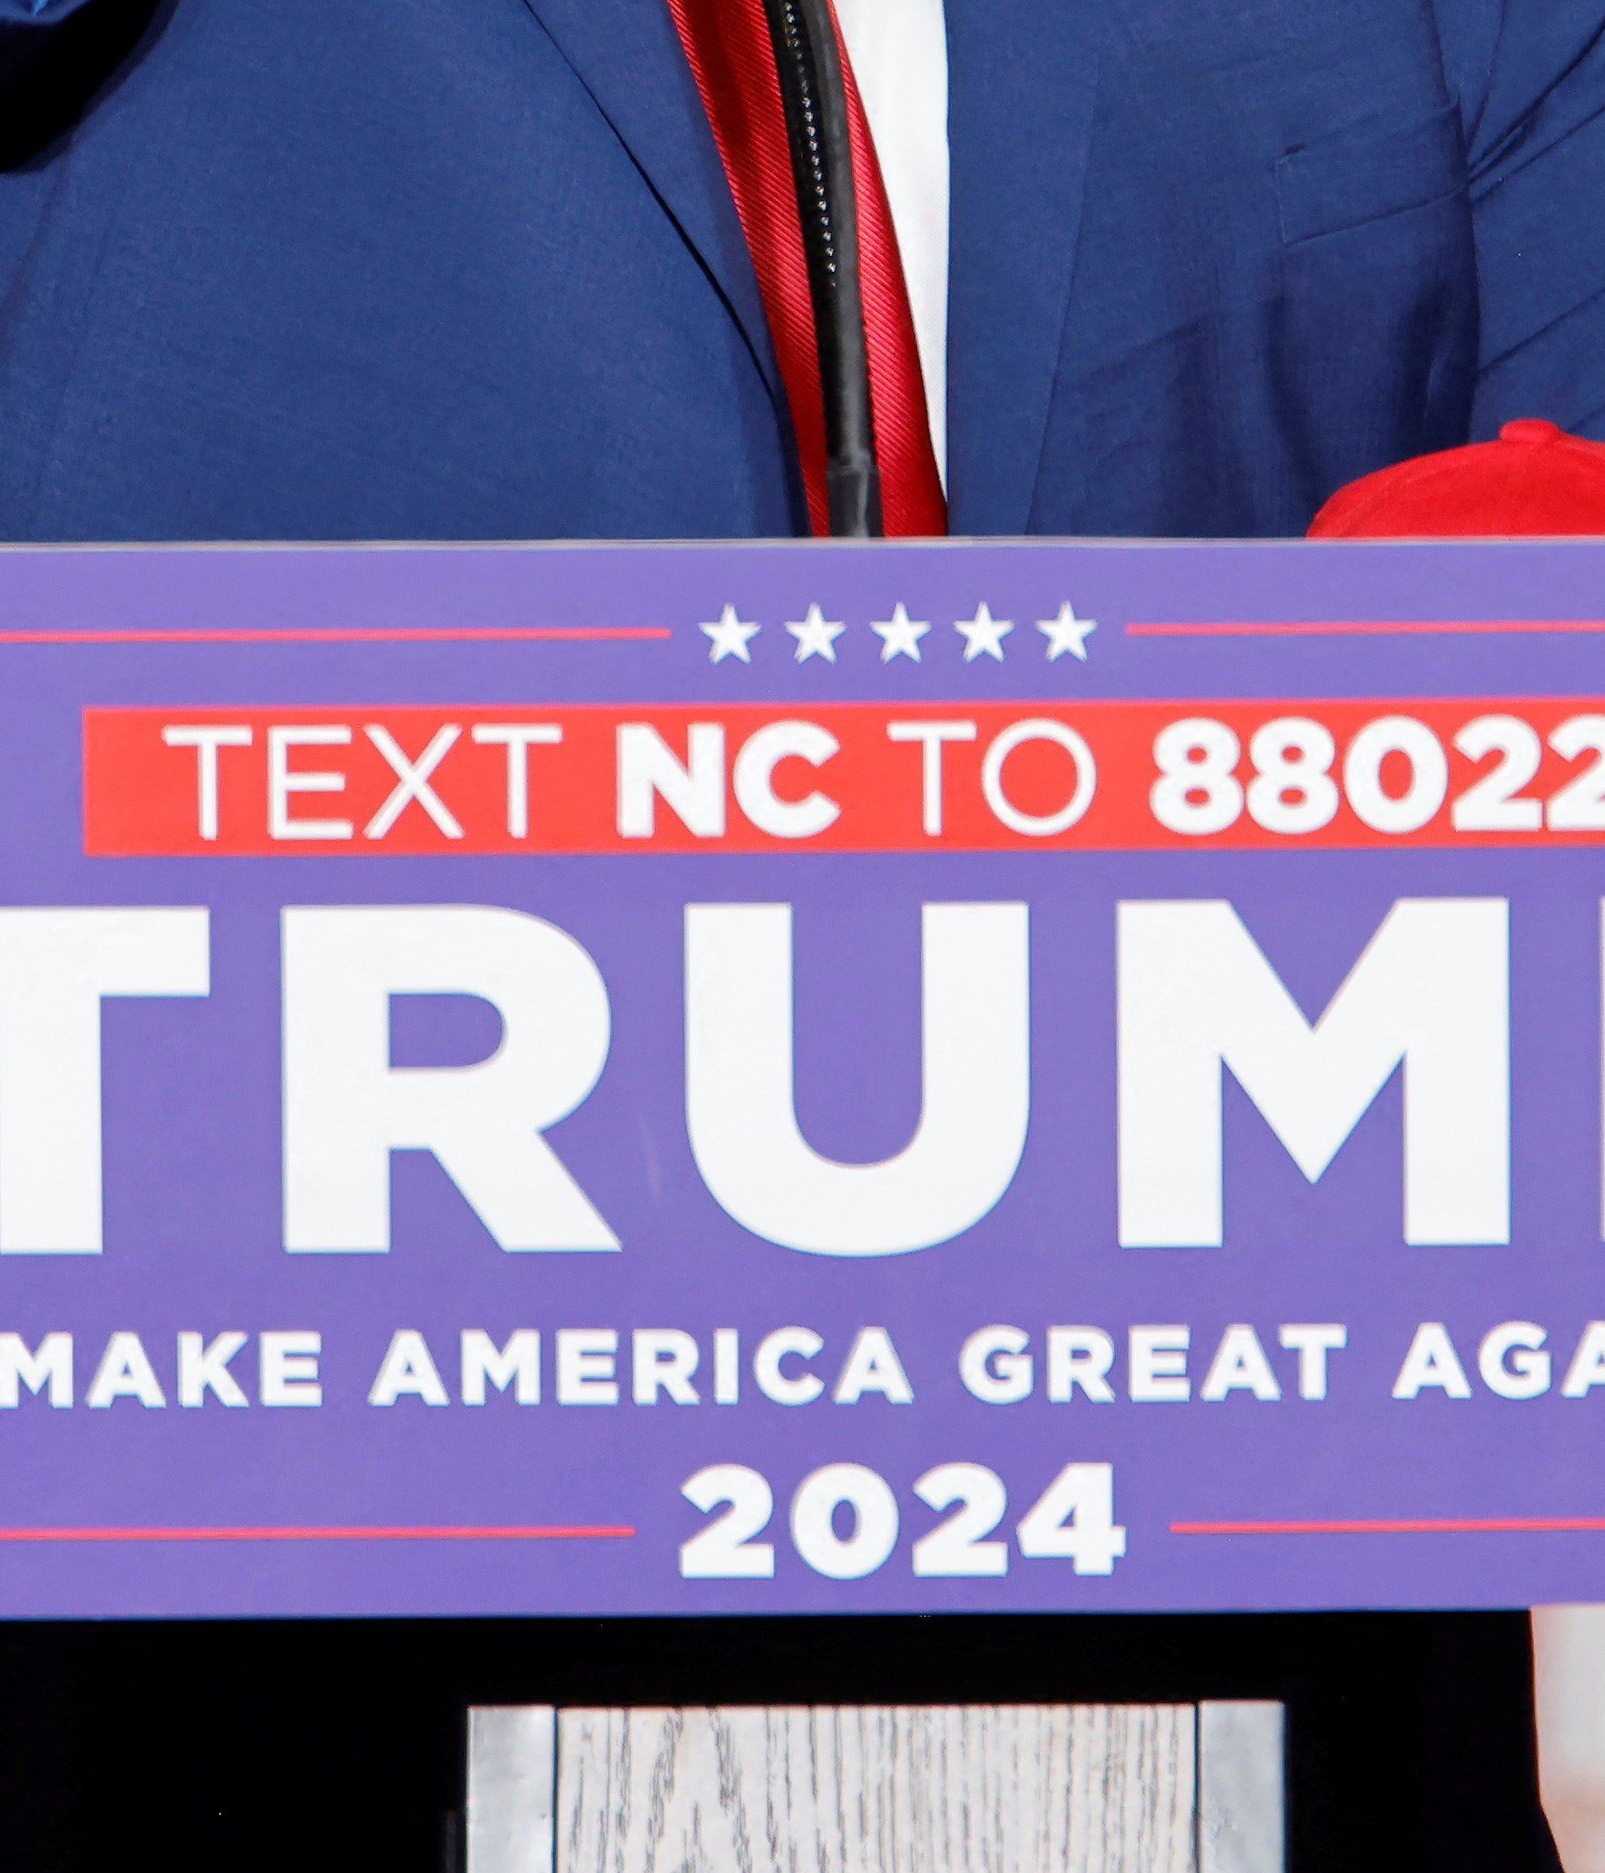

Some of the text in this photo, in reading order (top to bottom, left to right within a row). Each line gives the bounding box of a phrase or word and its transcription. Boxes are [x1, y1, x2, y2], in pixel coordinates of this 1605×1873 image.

[163, 724, 562, 840] TEXT
[617, 721, 840, 838] NC
[887, 719, 1097, 836] TO
[368, 1326, 914, 1407] AMERICA
[959, 1323, 1346, 1404] GREAT
[679, 1462, 1127, 1579] 2024
